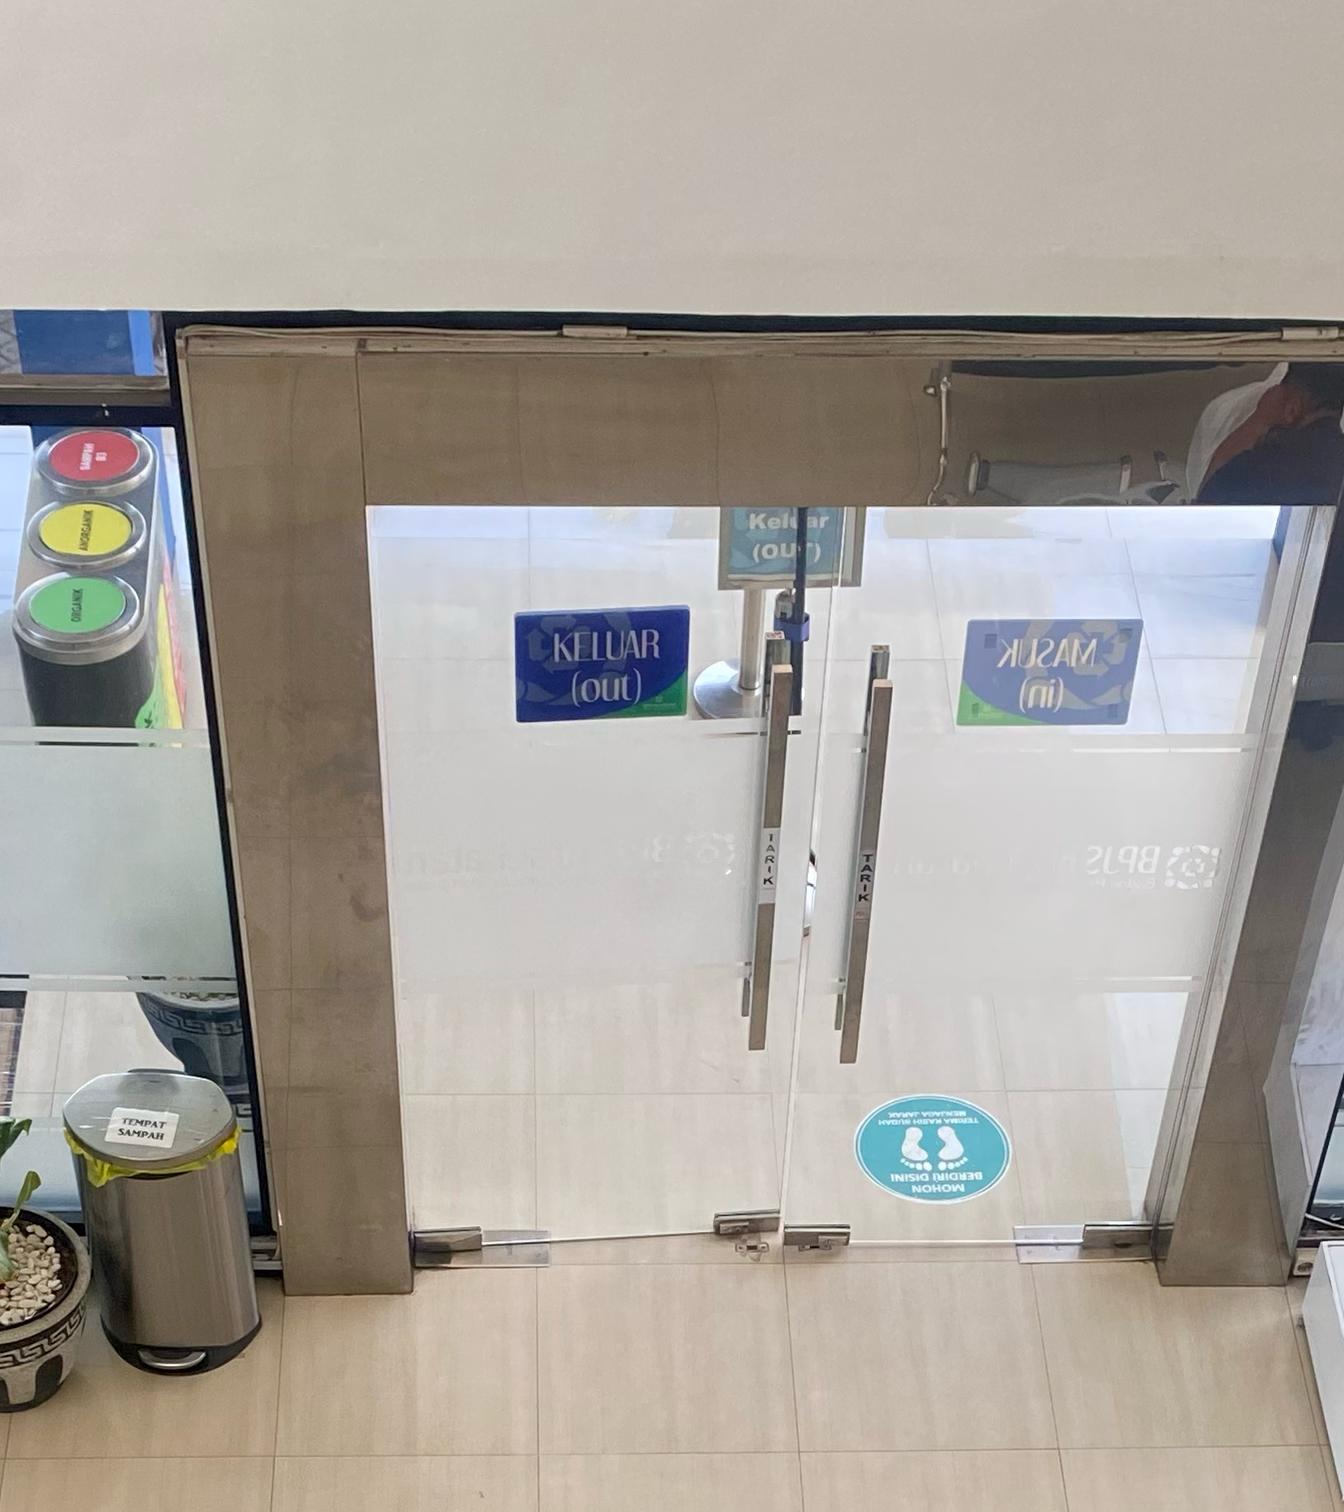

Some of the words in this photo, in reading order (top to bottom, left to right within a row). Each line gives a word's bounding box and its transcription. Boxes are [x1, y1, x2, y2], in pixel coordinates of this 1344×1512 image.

[71, 589, 83, 622] ORGANIK
[553, 629, 660, 662] KELUAR
[572, 667, 642, 707] (out)
[858, 854, 874, 902] TARIK
[122, 1118, 166, 1129] TEMPAT
[118, 1128, 164, 1140] SAMPAH
[890, 1173, 929, 1182] DISINI
[933, 1171, 983, 1182] BERDIRI
[911, 1184, 965, 1193] MOHON
